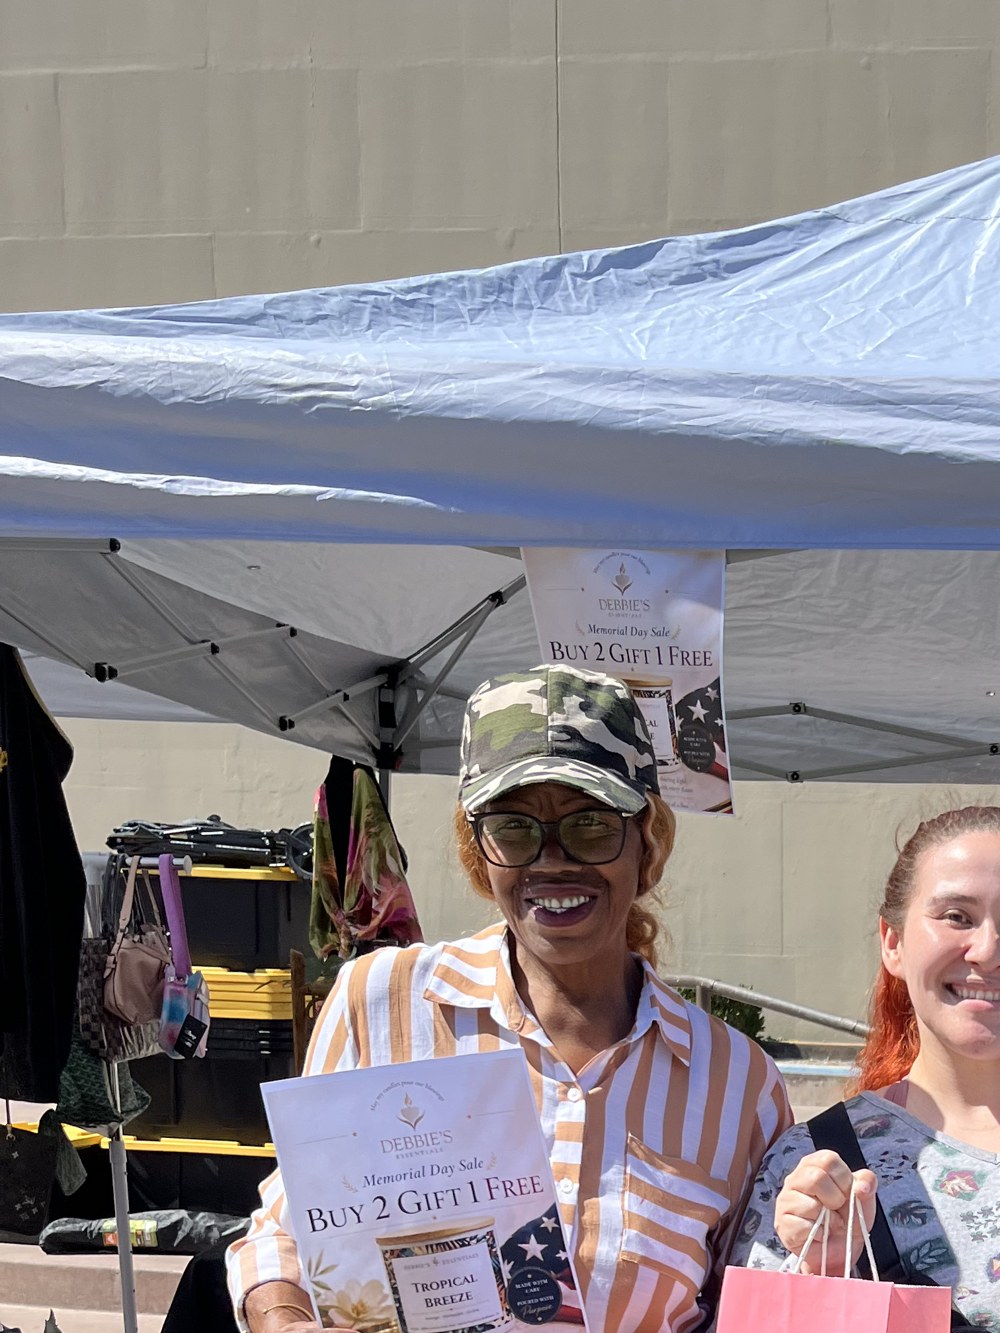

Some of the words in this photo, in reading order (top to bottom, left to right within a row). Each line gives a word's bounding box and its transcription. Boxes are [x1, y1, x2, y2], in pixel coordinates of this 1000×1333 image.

[598, 598, 651, 612] DEBBIE'S
[588, 623, 628, 637] Memorial
[630, 626, 649, 640] Day
[651, 627, 671, 638] Sale
[549, 641, 589, 661] BUY
[593, 641, 606, 662] 2
[609, 643, 651, 665] GIFT
[655, 645, 664, 666] 1
[668, 646, 714, 667] FREE
[380, 1129, 454, 1154] DEBBIE'S
[362, 1170, 426, 1189] Memorial
[430, 1163, 456, 1179] Day
[458, 1157, 484, 1173] Sale
[306, 1203, 364, 1233] BUY
[372, 1195, 390, 1220] 2
[397, 1188, 462, 1215] GIFT
[467, 1180, 479, 1204] 1
[485, 1174, 545, 1201] FREE
[411, 1273, 478, 1293] TROPICAL
[424, 1291, 474, 1308] BREEZE
